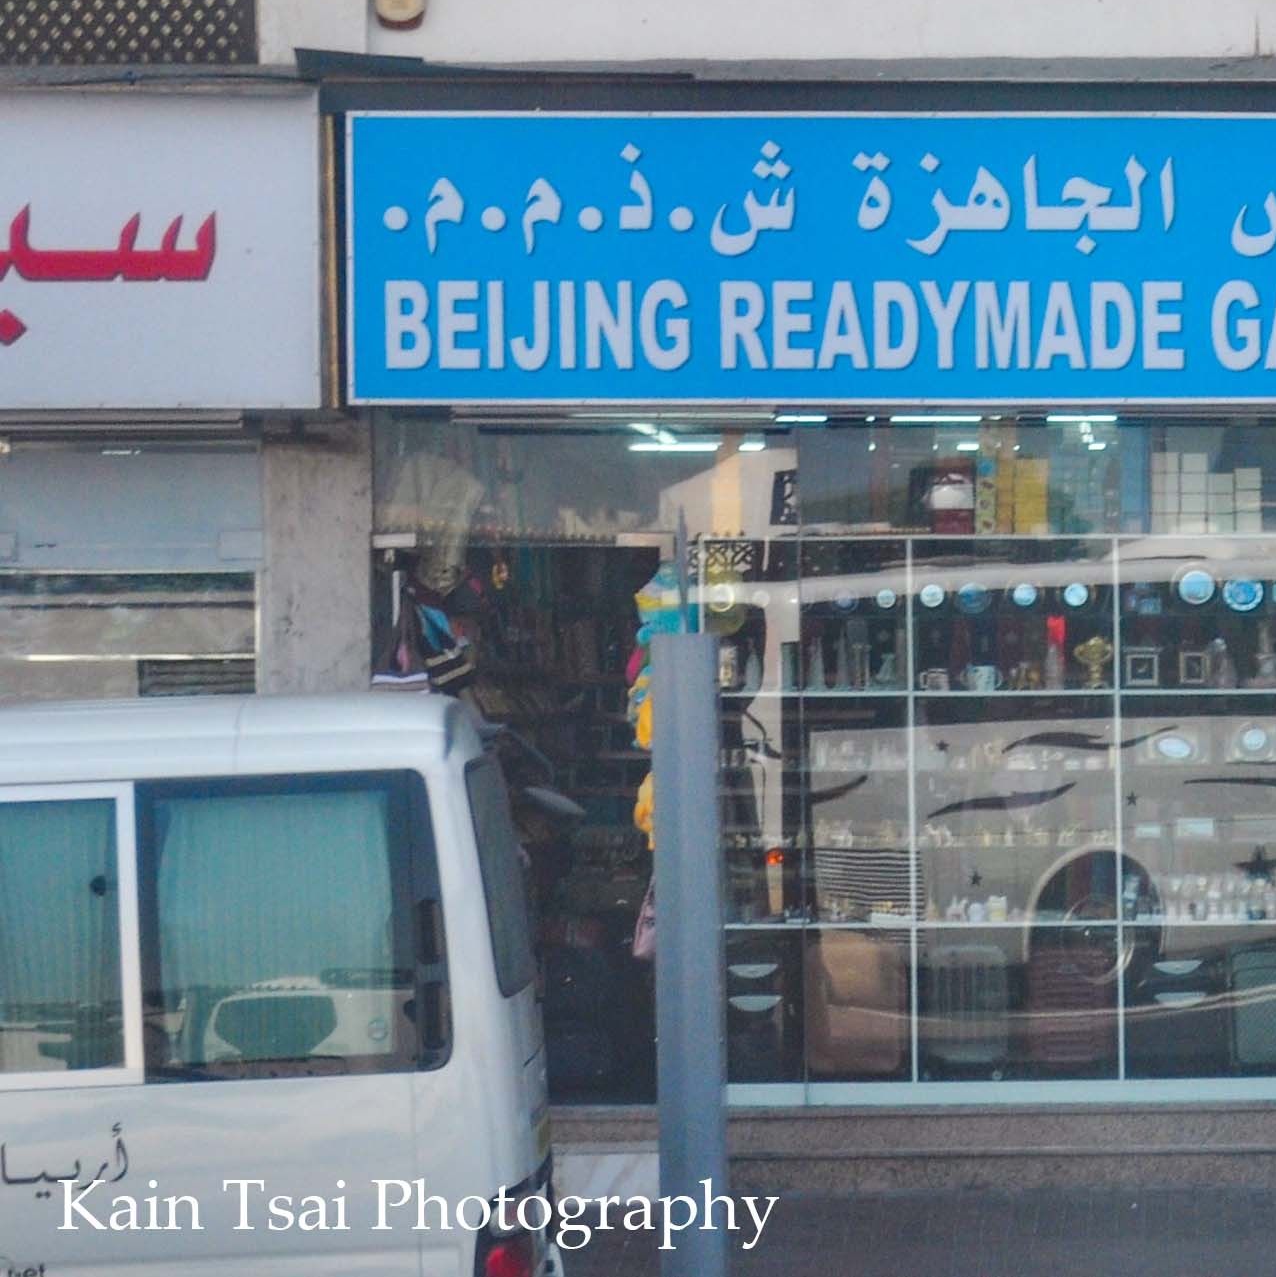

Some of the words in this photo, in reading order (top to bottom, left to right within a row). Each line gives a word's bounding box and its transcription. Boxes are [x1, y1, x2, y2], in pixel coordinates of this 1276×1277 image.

[852, 152, 1174, 255] الجاهزة
[385, 280, 690, 371] BEIJING
[720, 280, 1185, 370] READYMADE
